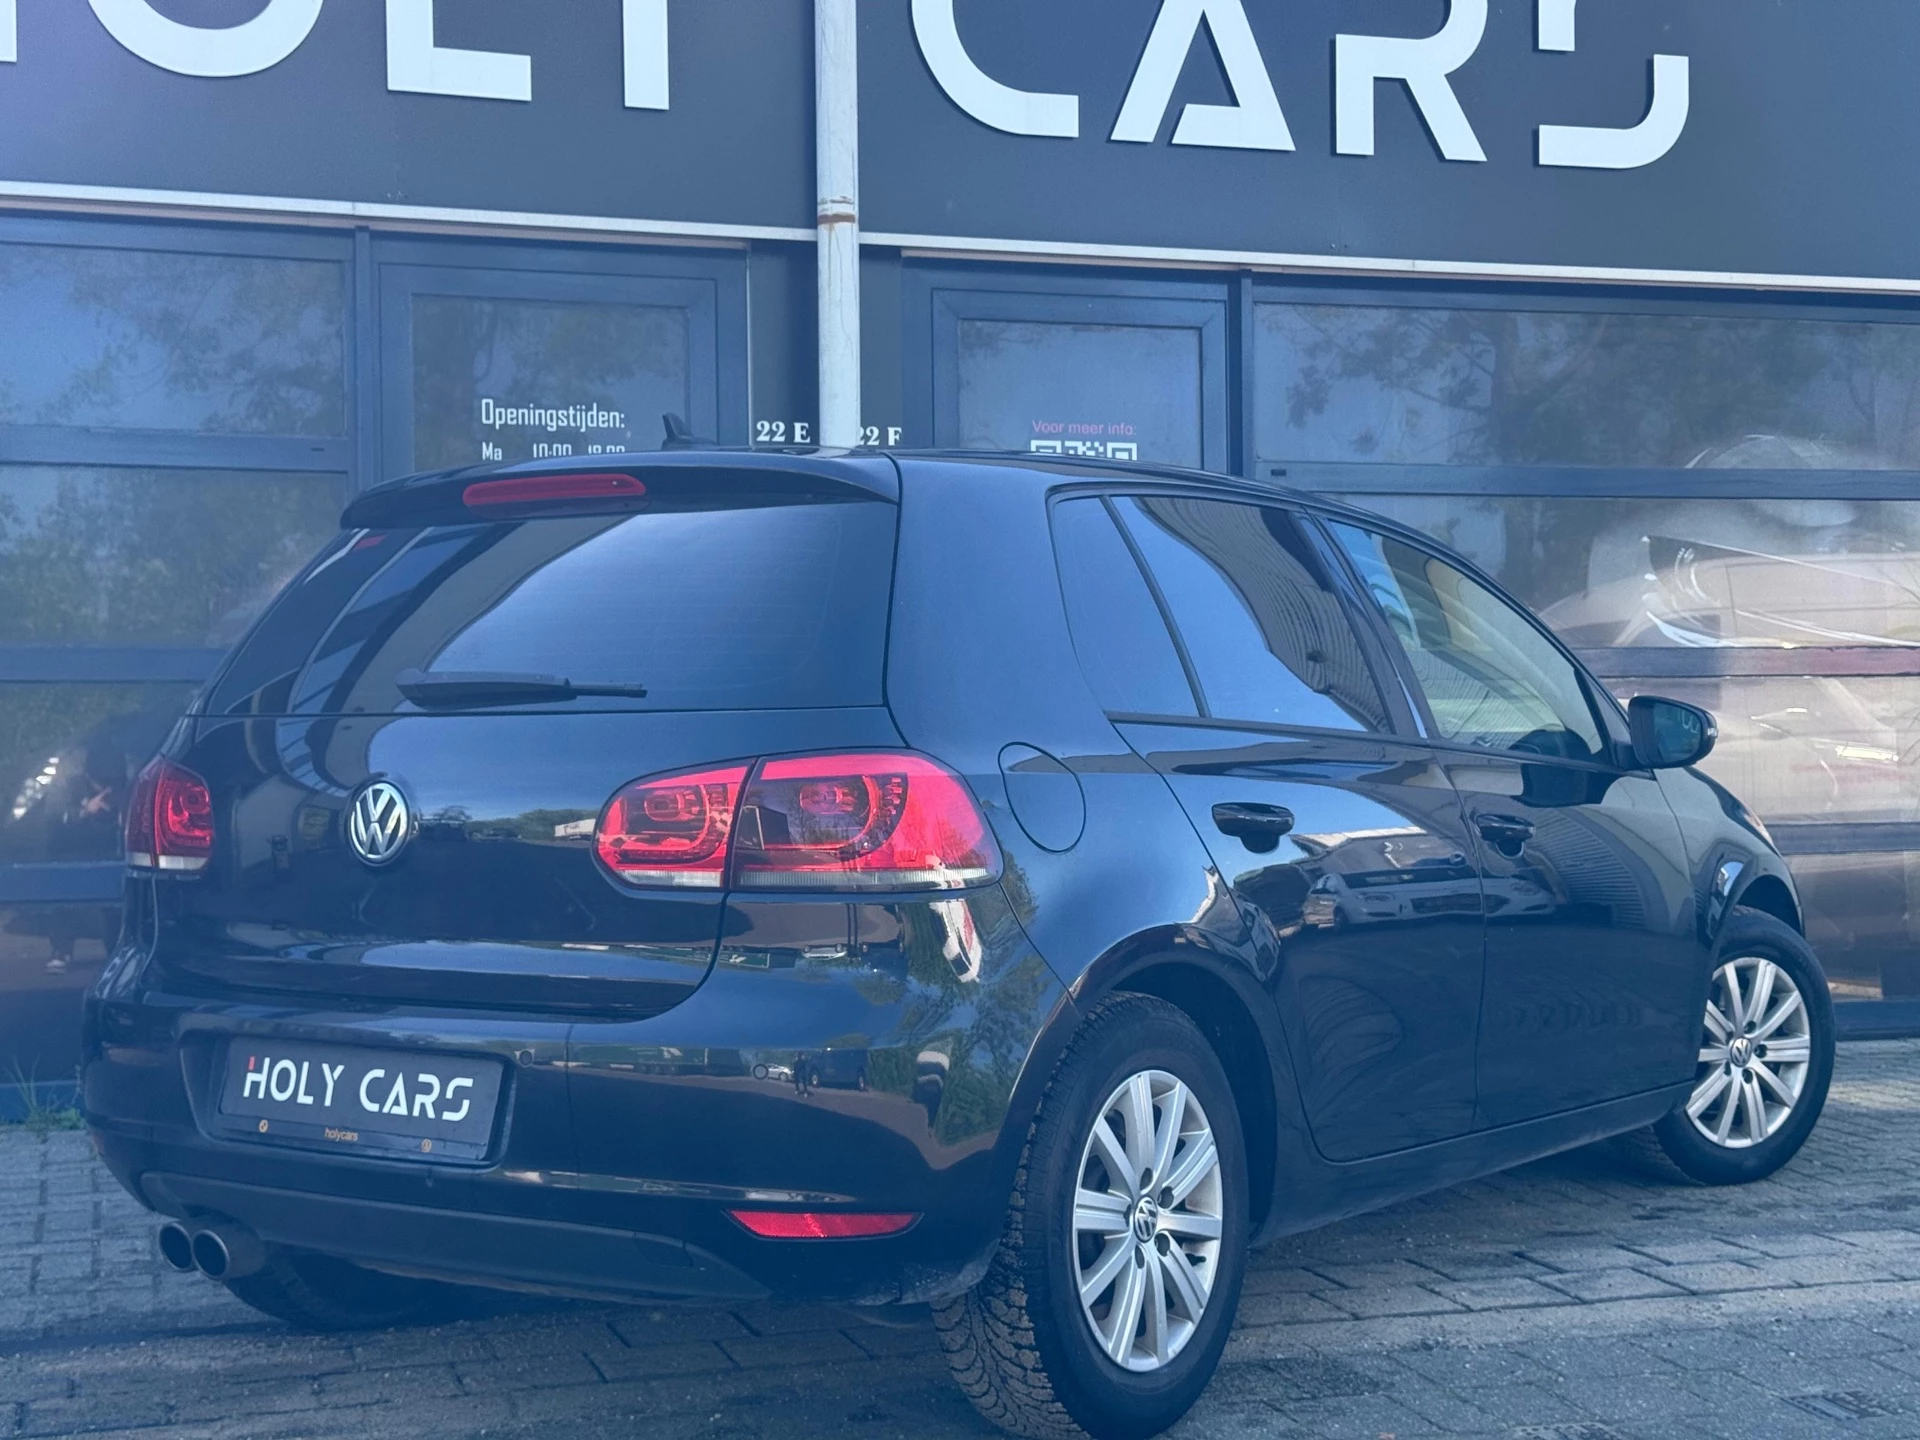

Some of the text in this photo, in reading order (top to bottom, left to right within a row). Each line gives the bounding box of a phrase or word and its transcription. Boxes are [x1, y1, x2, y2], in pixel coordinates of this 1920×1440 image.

[481, 398, 625, 432] Openingstijden:
[756, 420, 811, 443] 22 E
[887, 427, 902, 446] F
[1032, 420, 1136, 436] Voor meer info:
[481, 441, 502, 461] Ma
[243, 1055, 474, 1122] HOLY CARS
[324, 1127, 359, 1142] holycars
